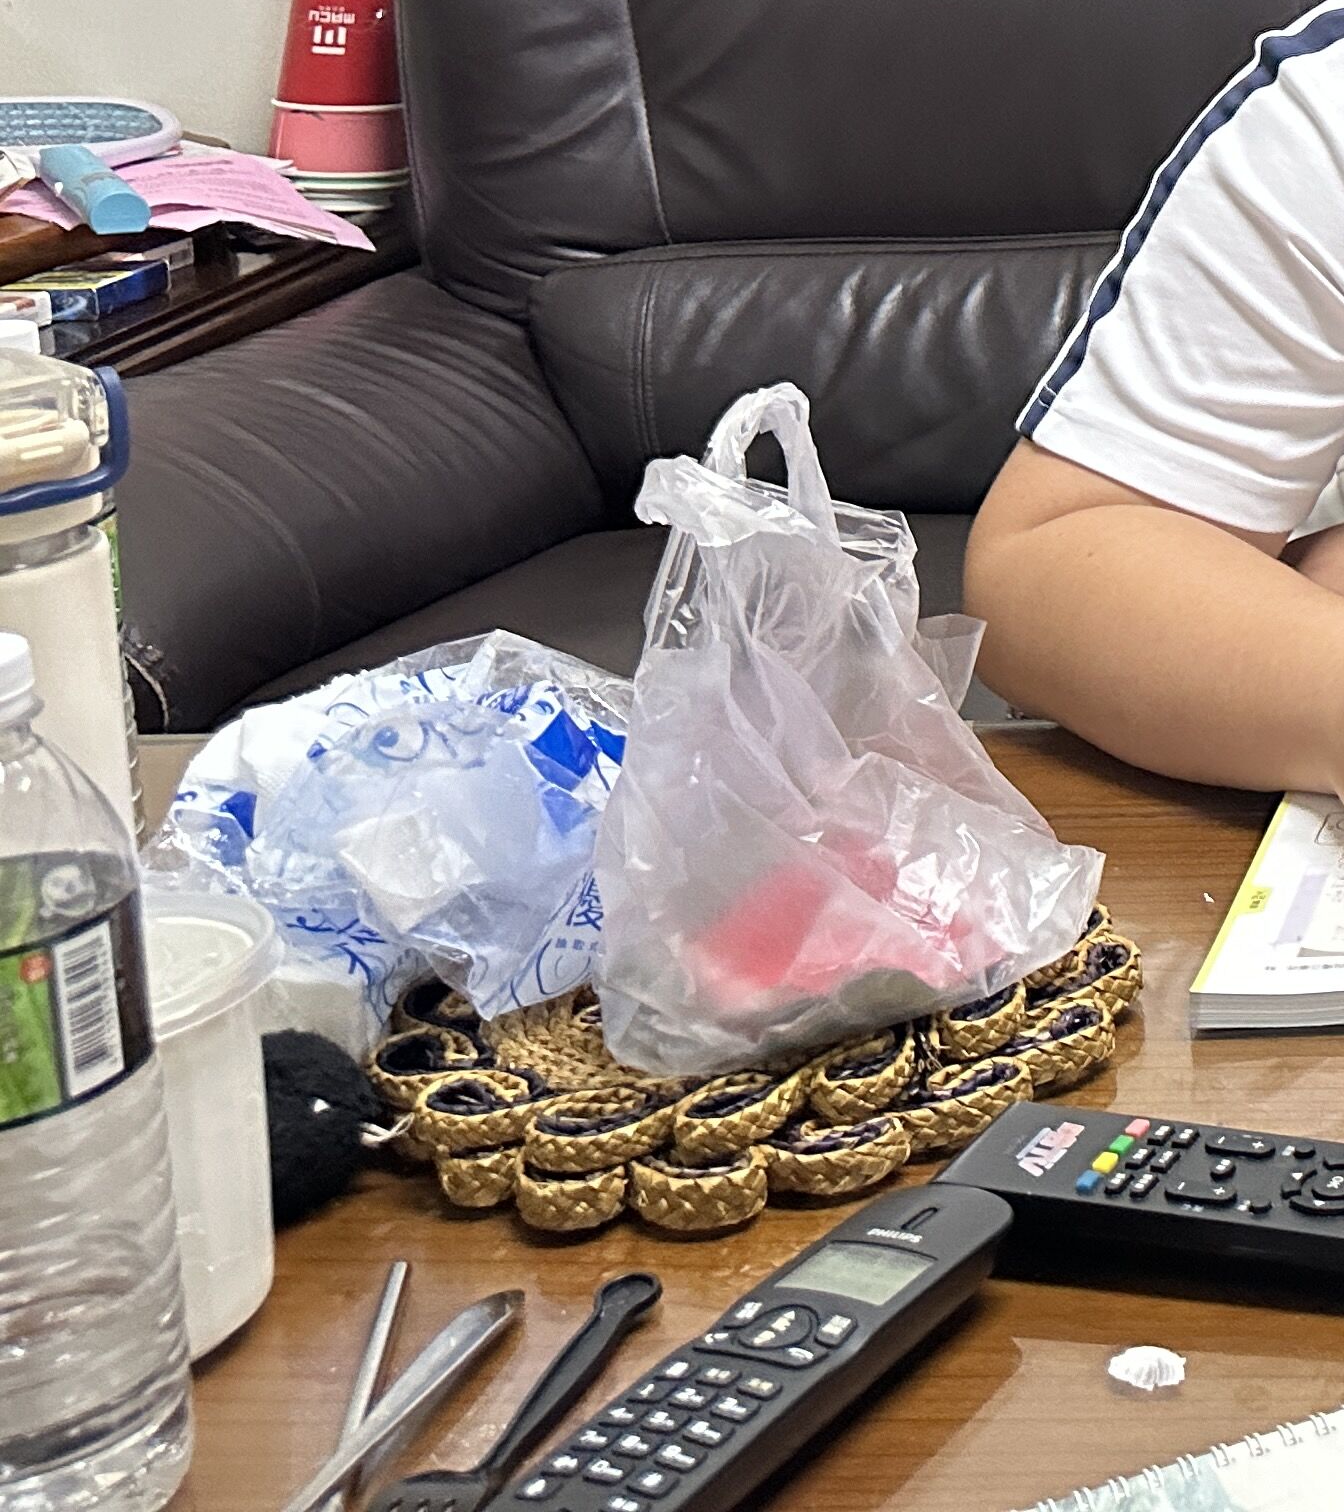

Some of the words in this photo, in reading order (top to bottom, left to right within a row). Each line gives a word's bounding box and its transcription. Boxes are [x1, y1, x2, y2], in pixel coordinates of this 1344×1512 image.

[308, 9, 356, 24] MACU
[1325, 1175, 1344, 1190] OK
[866, 1228, 923, 1244] PHILIPS
